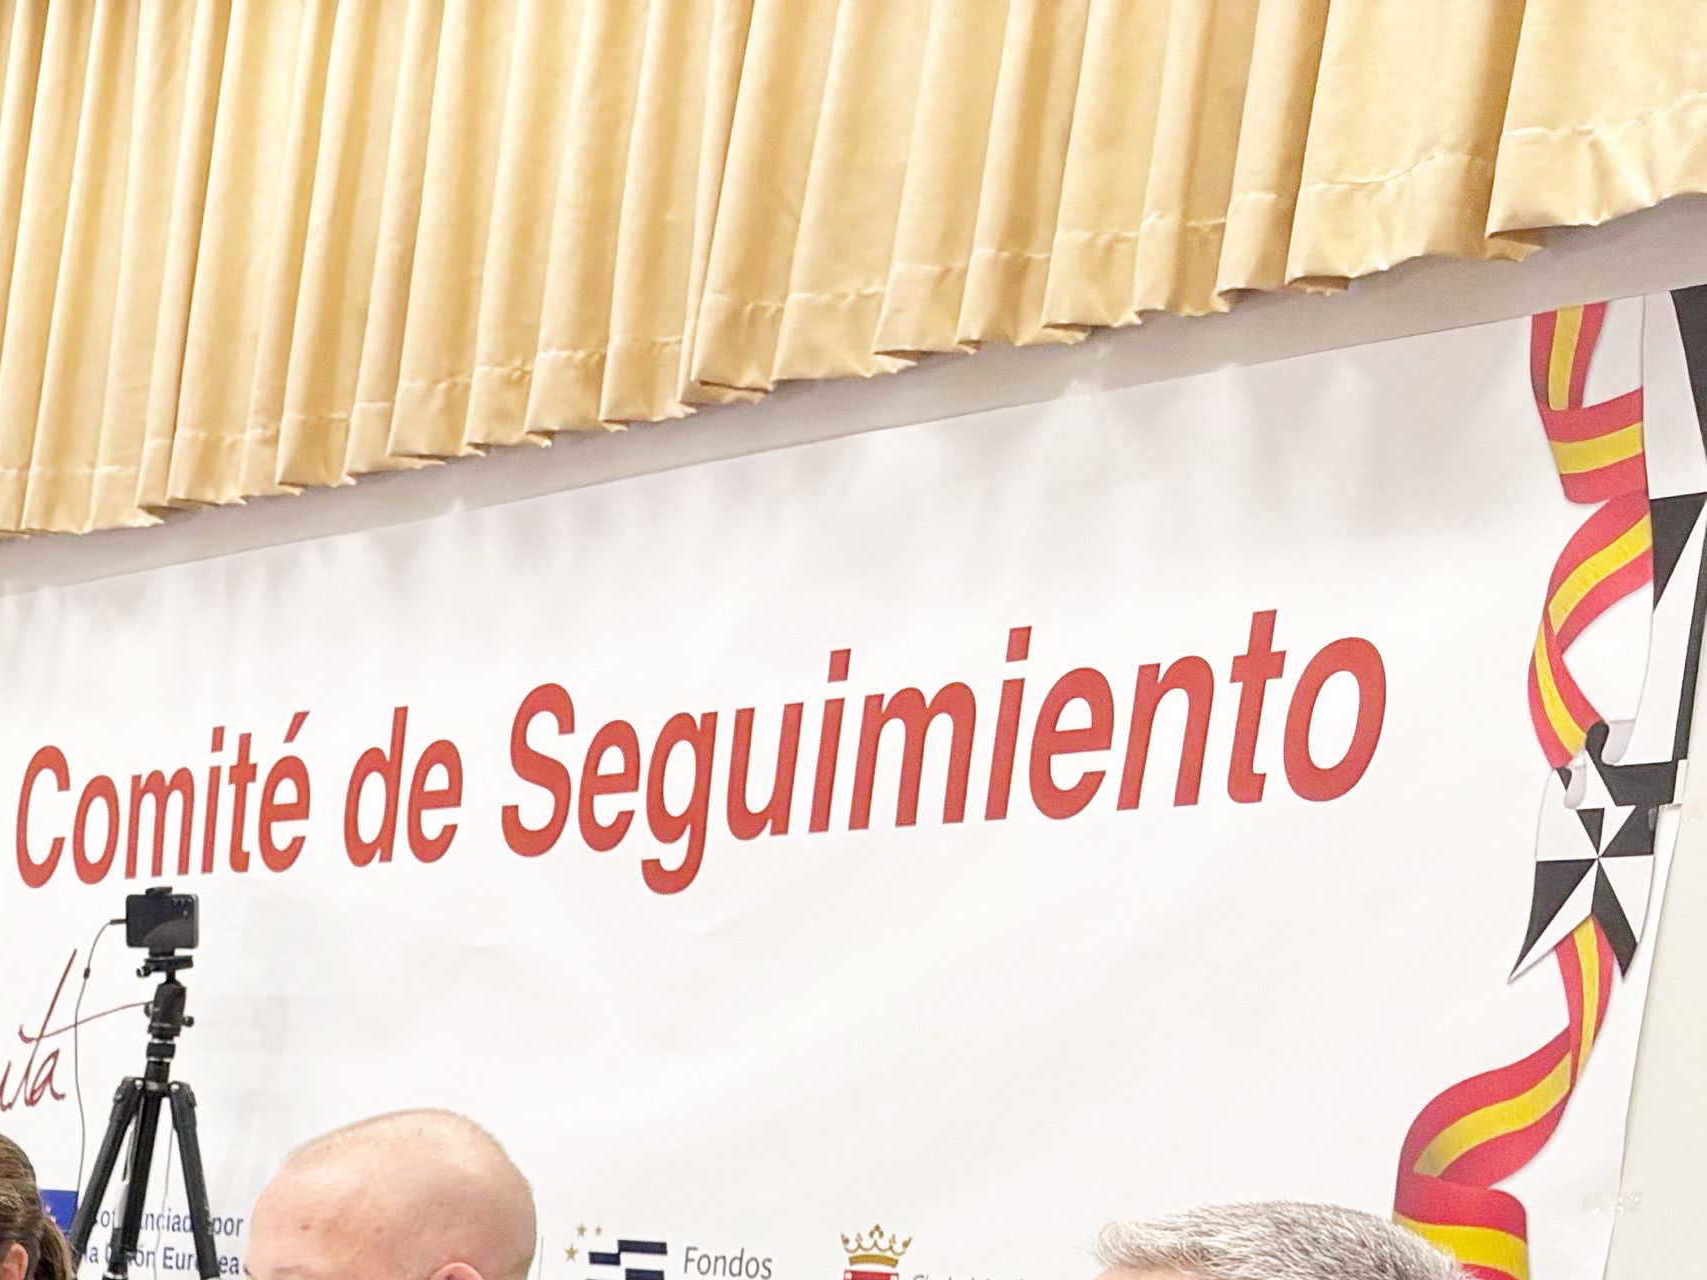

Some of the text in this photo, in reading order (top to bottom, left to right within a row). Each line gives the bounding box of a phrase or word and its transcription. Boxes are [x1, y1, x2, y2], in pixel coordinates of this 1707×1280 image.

[16, 608, 1388, 894] Comité de Seguimiento
[162, 1246, 240, 1275] Eurea
[684, 1246, 773, 1280] Fondos
